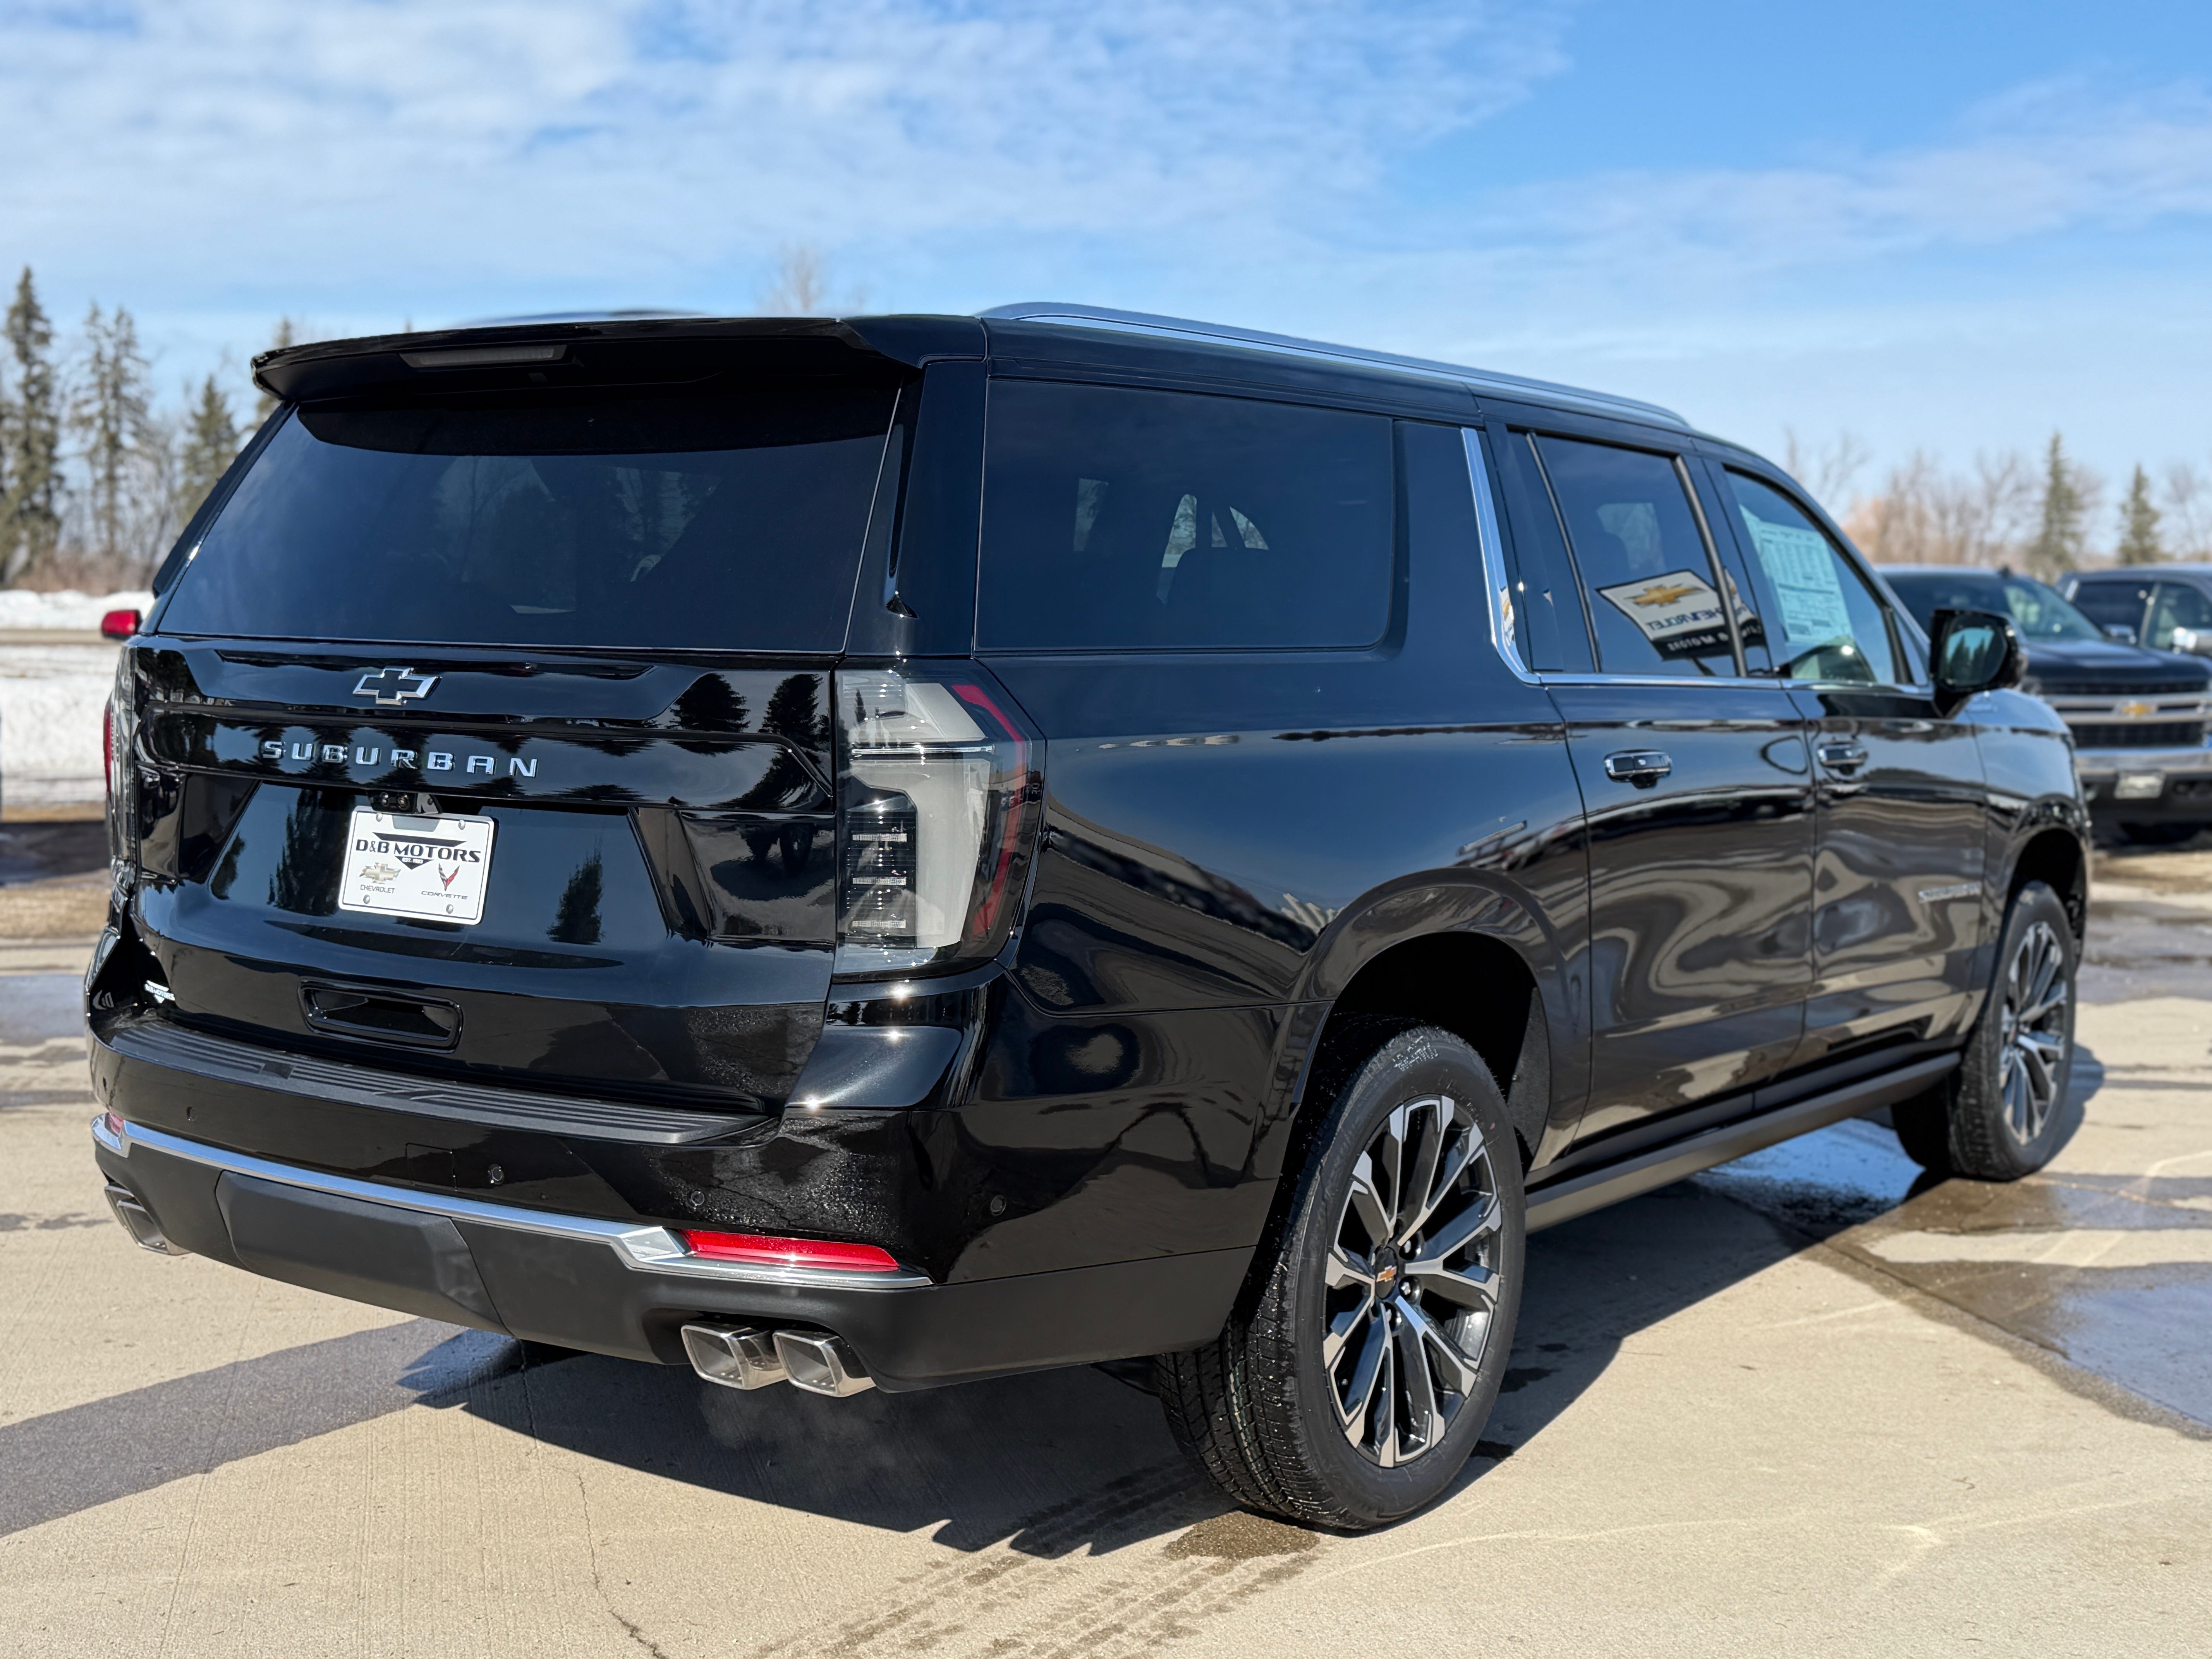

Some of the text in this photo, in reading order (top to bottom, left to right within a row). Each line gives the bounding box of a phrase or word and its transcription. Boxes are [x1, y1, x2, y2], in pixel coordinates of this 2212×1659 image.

[262, 741, 539, 778] SUBURBAN
[356, 839, 481, 863] D&B MOTORS
[360, 884, 395, 893] CHEVROLET
[421, 891, 468, 900] CORVETTE
